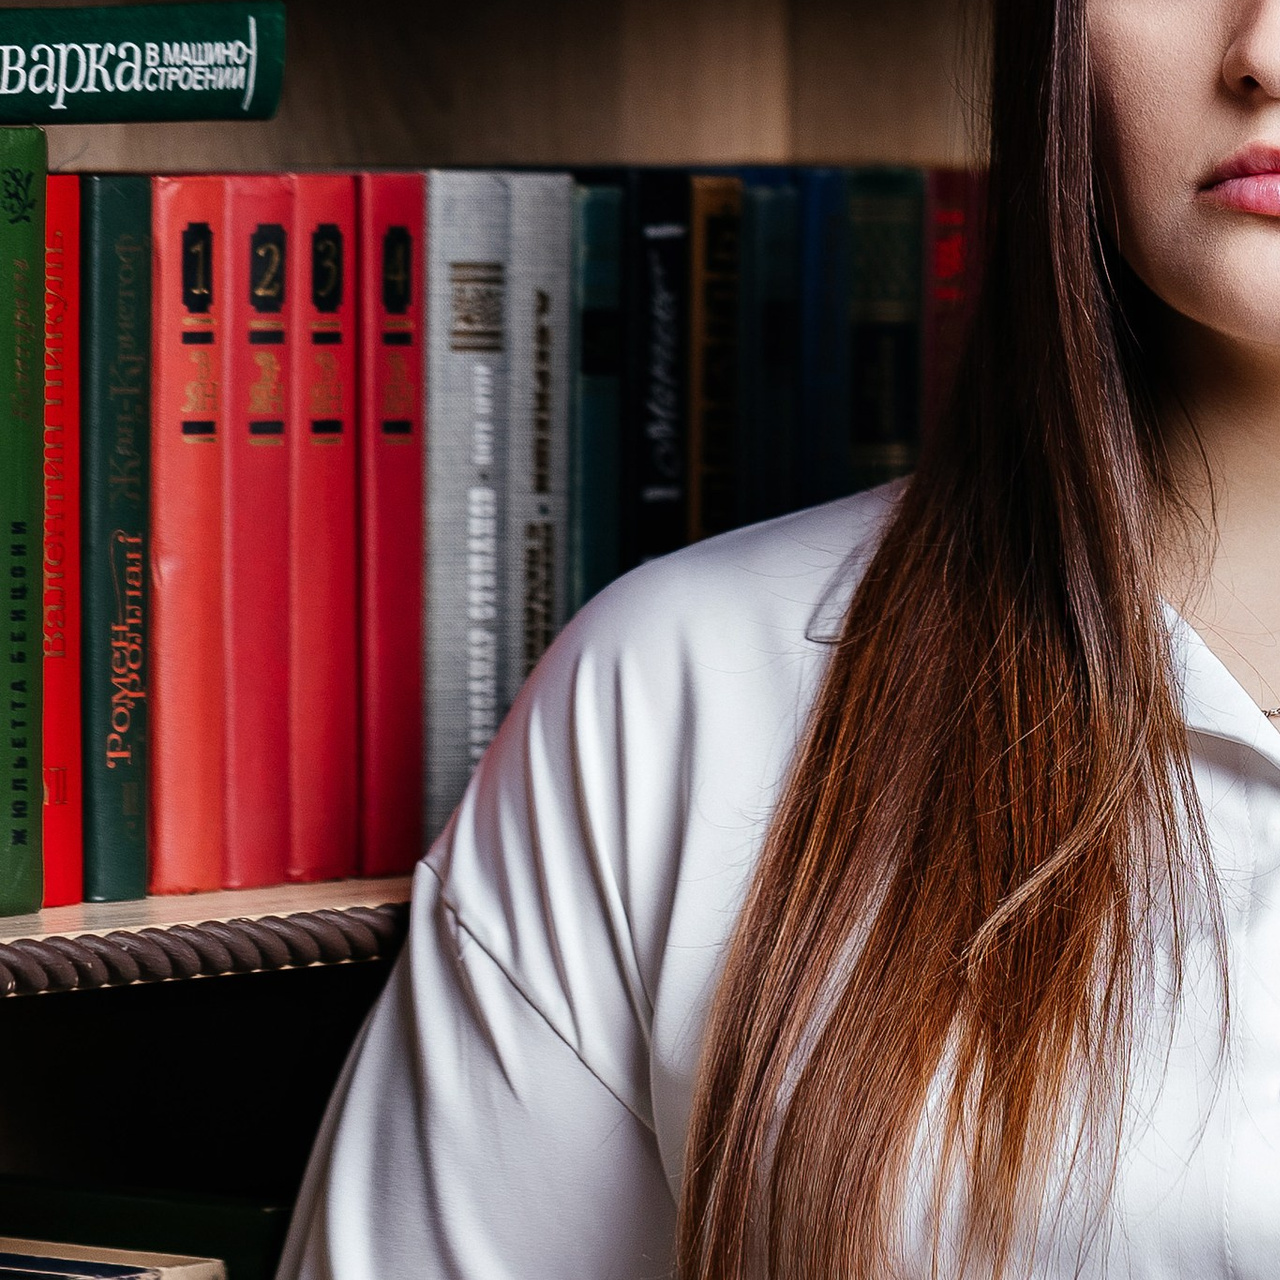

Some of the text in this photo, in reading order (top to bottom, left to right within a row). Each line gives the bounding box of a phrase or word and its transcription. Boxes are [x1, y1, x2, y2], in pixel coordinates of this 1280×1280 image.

[144, 66, 247, 93] СТРОЕНИИ
[145, 41, 161, 68] В
[189, 239, 210, 296] 1
[255, 243, 282, 297] 2
[315, 240, 337, 298] 3
[386, 243, 408, 297] 4
[9, 680, 29, 846] ЖЮЛЬЕТТА
